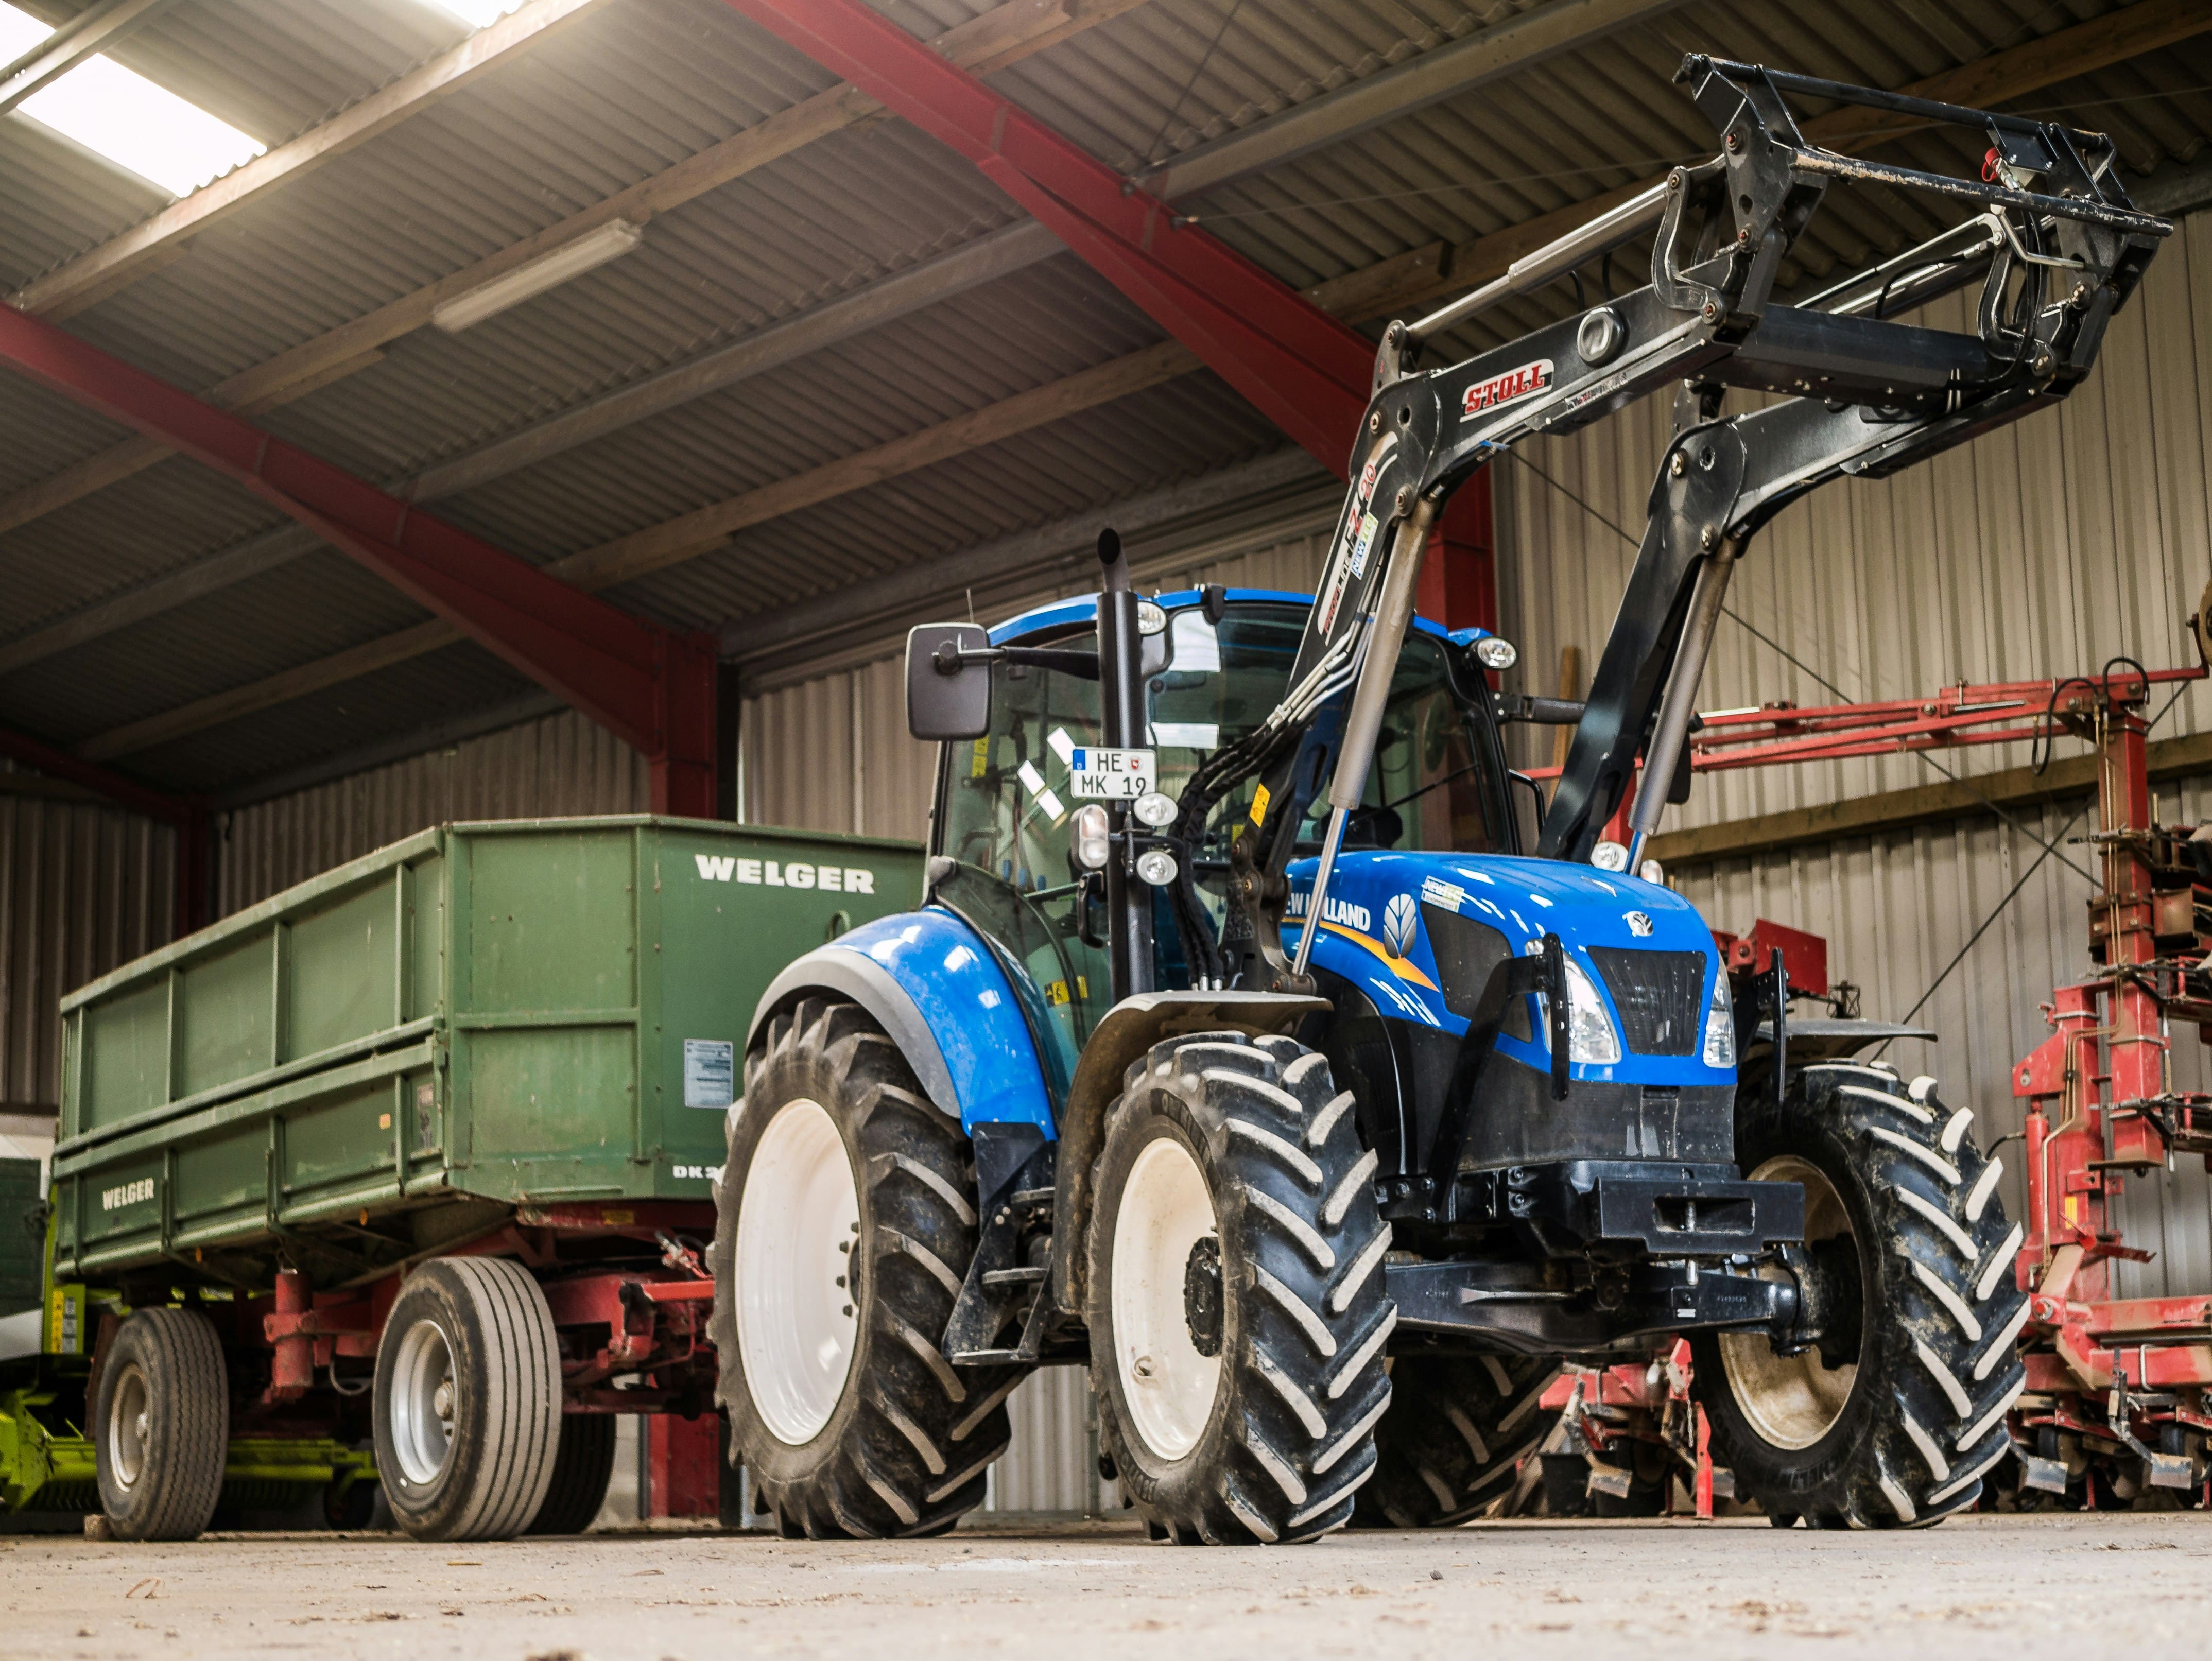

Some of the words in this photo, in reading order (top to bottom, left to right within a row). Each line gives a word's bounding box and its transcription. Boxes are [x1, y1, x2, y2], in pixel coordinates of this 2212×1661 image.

[1465, 364, 1545, 414] STOLL
[1361, 464, 1376, 500] 20
[1098, 753, 1123, 772] HE
[1082, 774, 1107, 794] MK
[1123, 776, 1146, 797] 19
[695, 855, 875, 895] WELGER
[102, 1178, 154, 1211] WELGER
